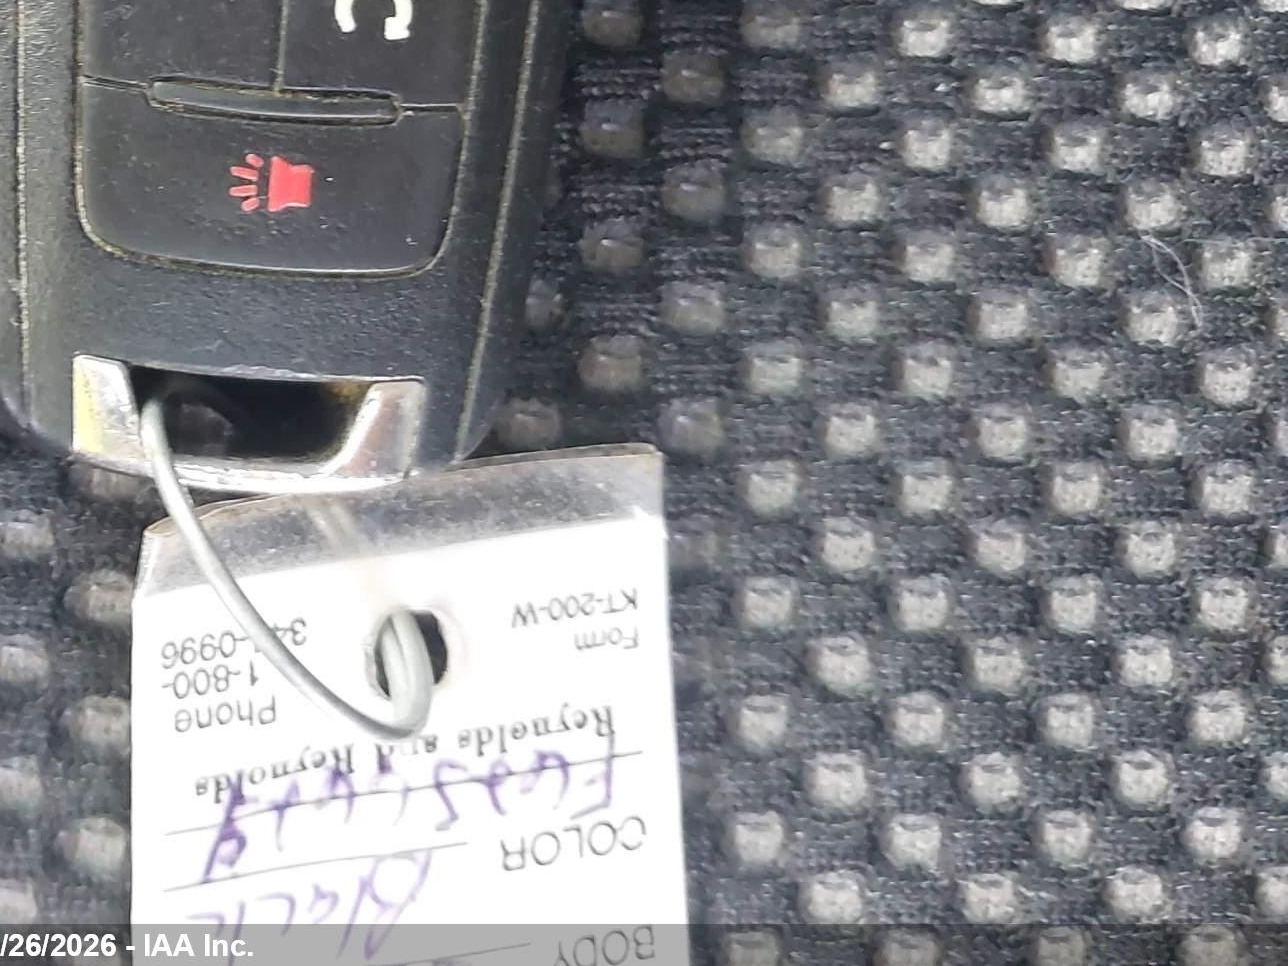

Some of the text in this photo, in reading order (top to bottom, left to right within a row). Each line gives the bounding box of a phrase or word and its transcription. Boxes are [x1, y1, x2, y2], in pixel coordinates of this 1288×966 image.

[510, 588, 639, 629] KT-200-W
[160, 617, 309, 669] 34-0996
[573, 626, 640, 650] Form
[161, 661, 259, 700] 1-800-
[173, 695, 277, 732] Phone
[194, 705, 616, 805] Reynolds and Reynolds
[500, 816, 648, 872] COLOR
[554, 925, 656, 966] BODY
